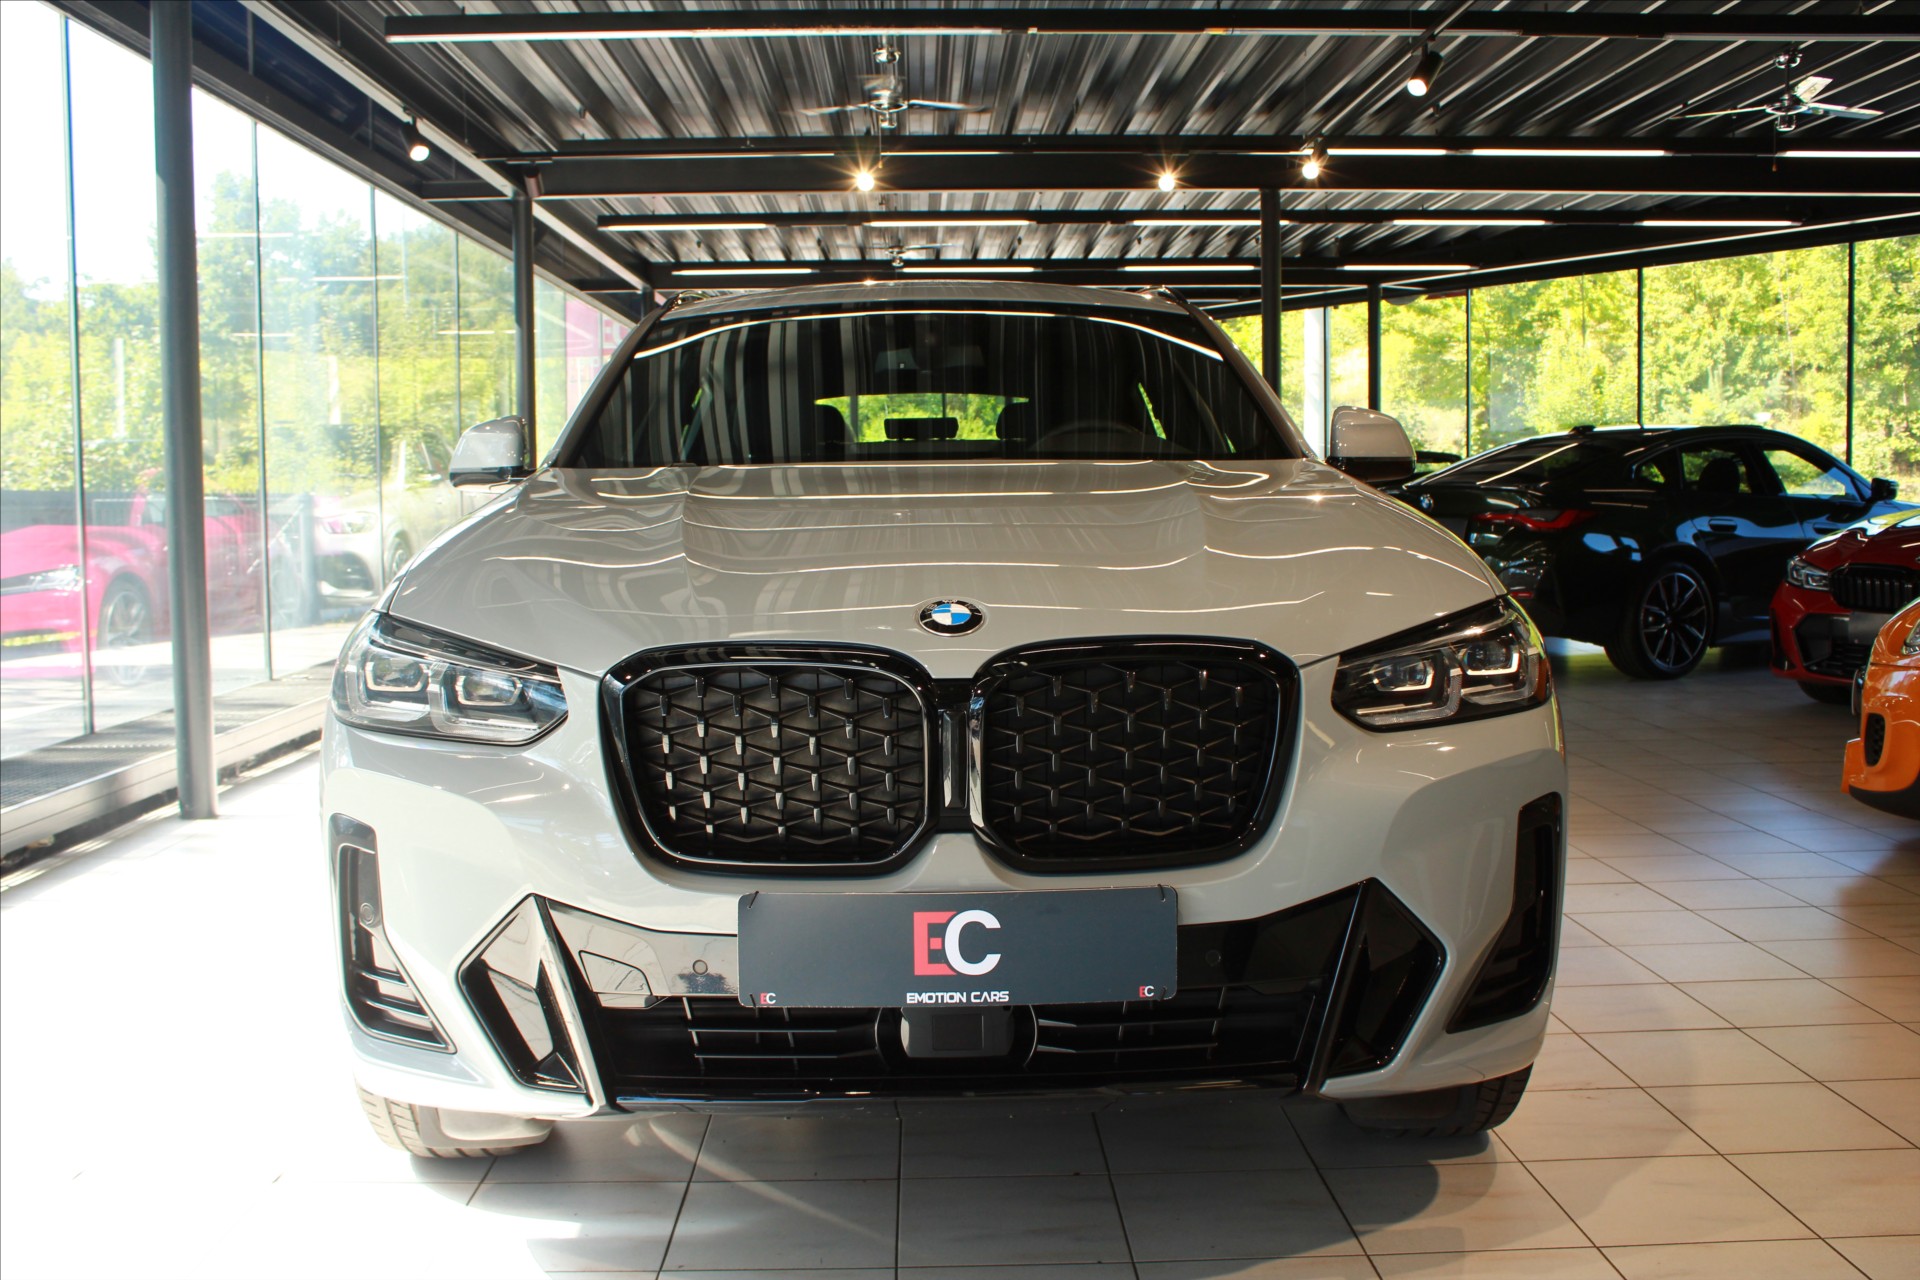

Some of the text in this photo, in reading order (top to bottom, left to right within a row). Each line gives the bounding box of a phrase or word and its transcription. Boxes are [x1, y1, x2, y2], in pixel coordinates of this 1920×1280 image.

[913, 909, 1001, 976] EC
[906, 990, 1009, 1004] EMOTION CARS
[1139, 985, 1155, 998] EC
[760, 992, 776, 1005] EC
